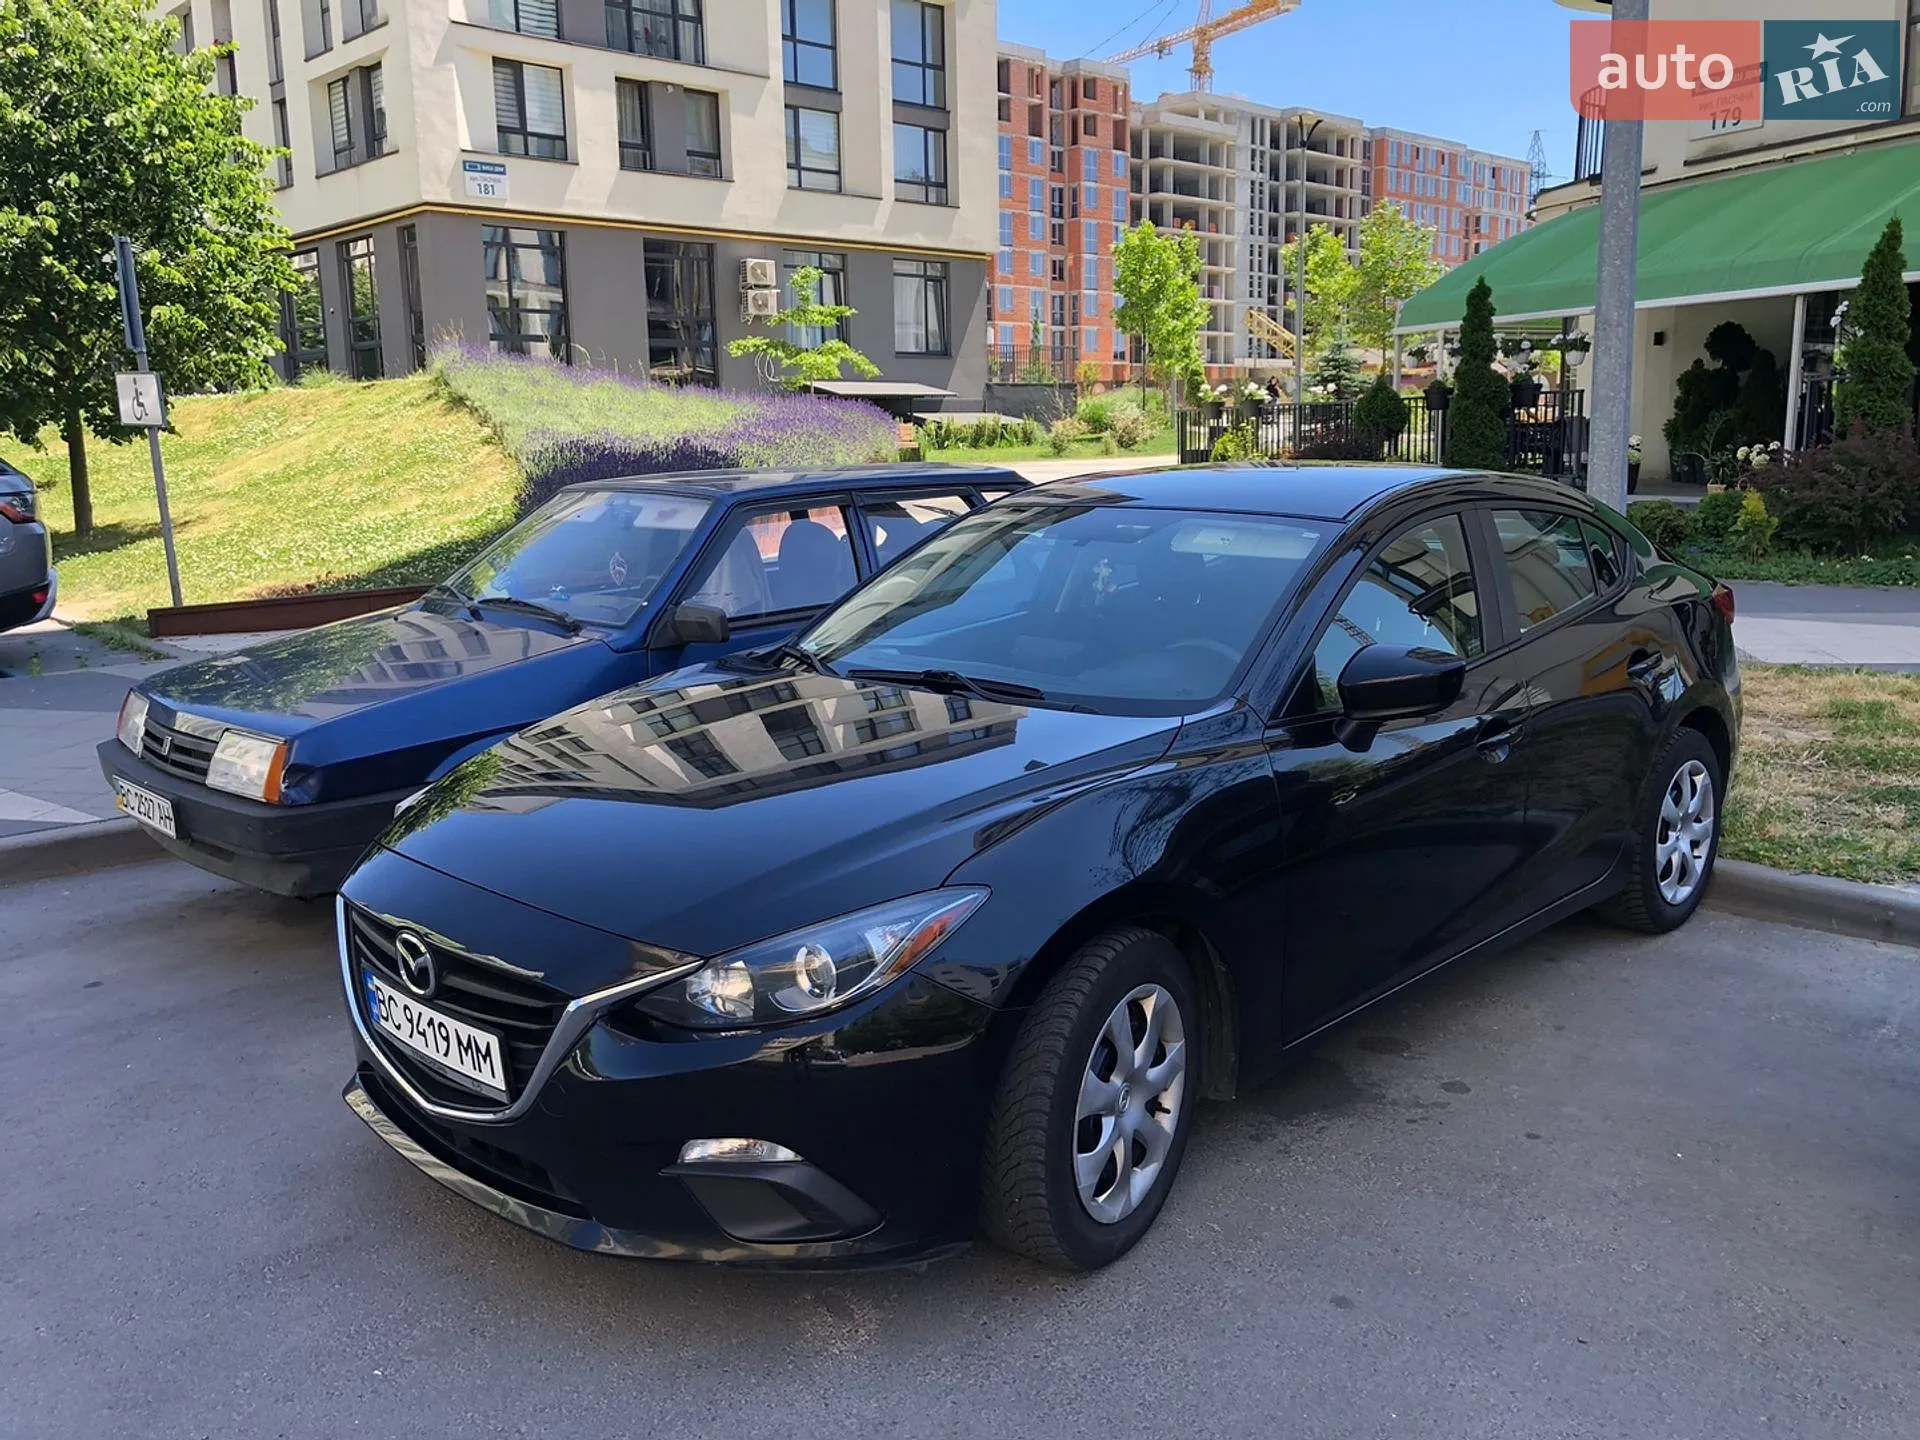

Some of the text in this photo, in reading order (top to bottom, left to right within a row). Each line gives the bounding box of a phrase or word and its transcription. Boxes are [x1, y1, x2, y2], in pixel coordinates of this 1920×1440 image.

[1710, 106, 1742, 131] 179
[477, 183, 495, 196] 181
[135, 791, 155, 821] 2527
[375, 984, 402, 1031] BC
[403, 1004, 450, 1058] 9419
[454, 1028, 496, 1079] MM
